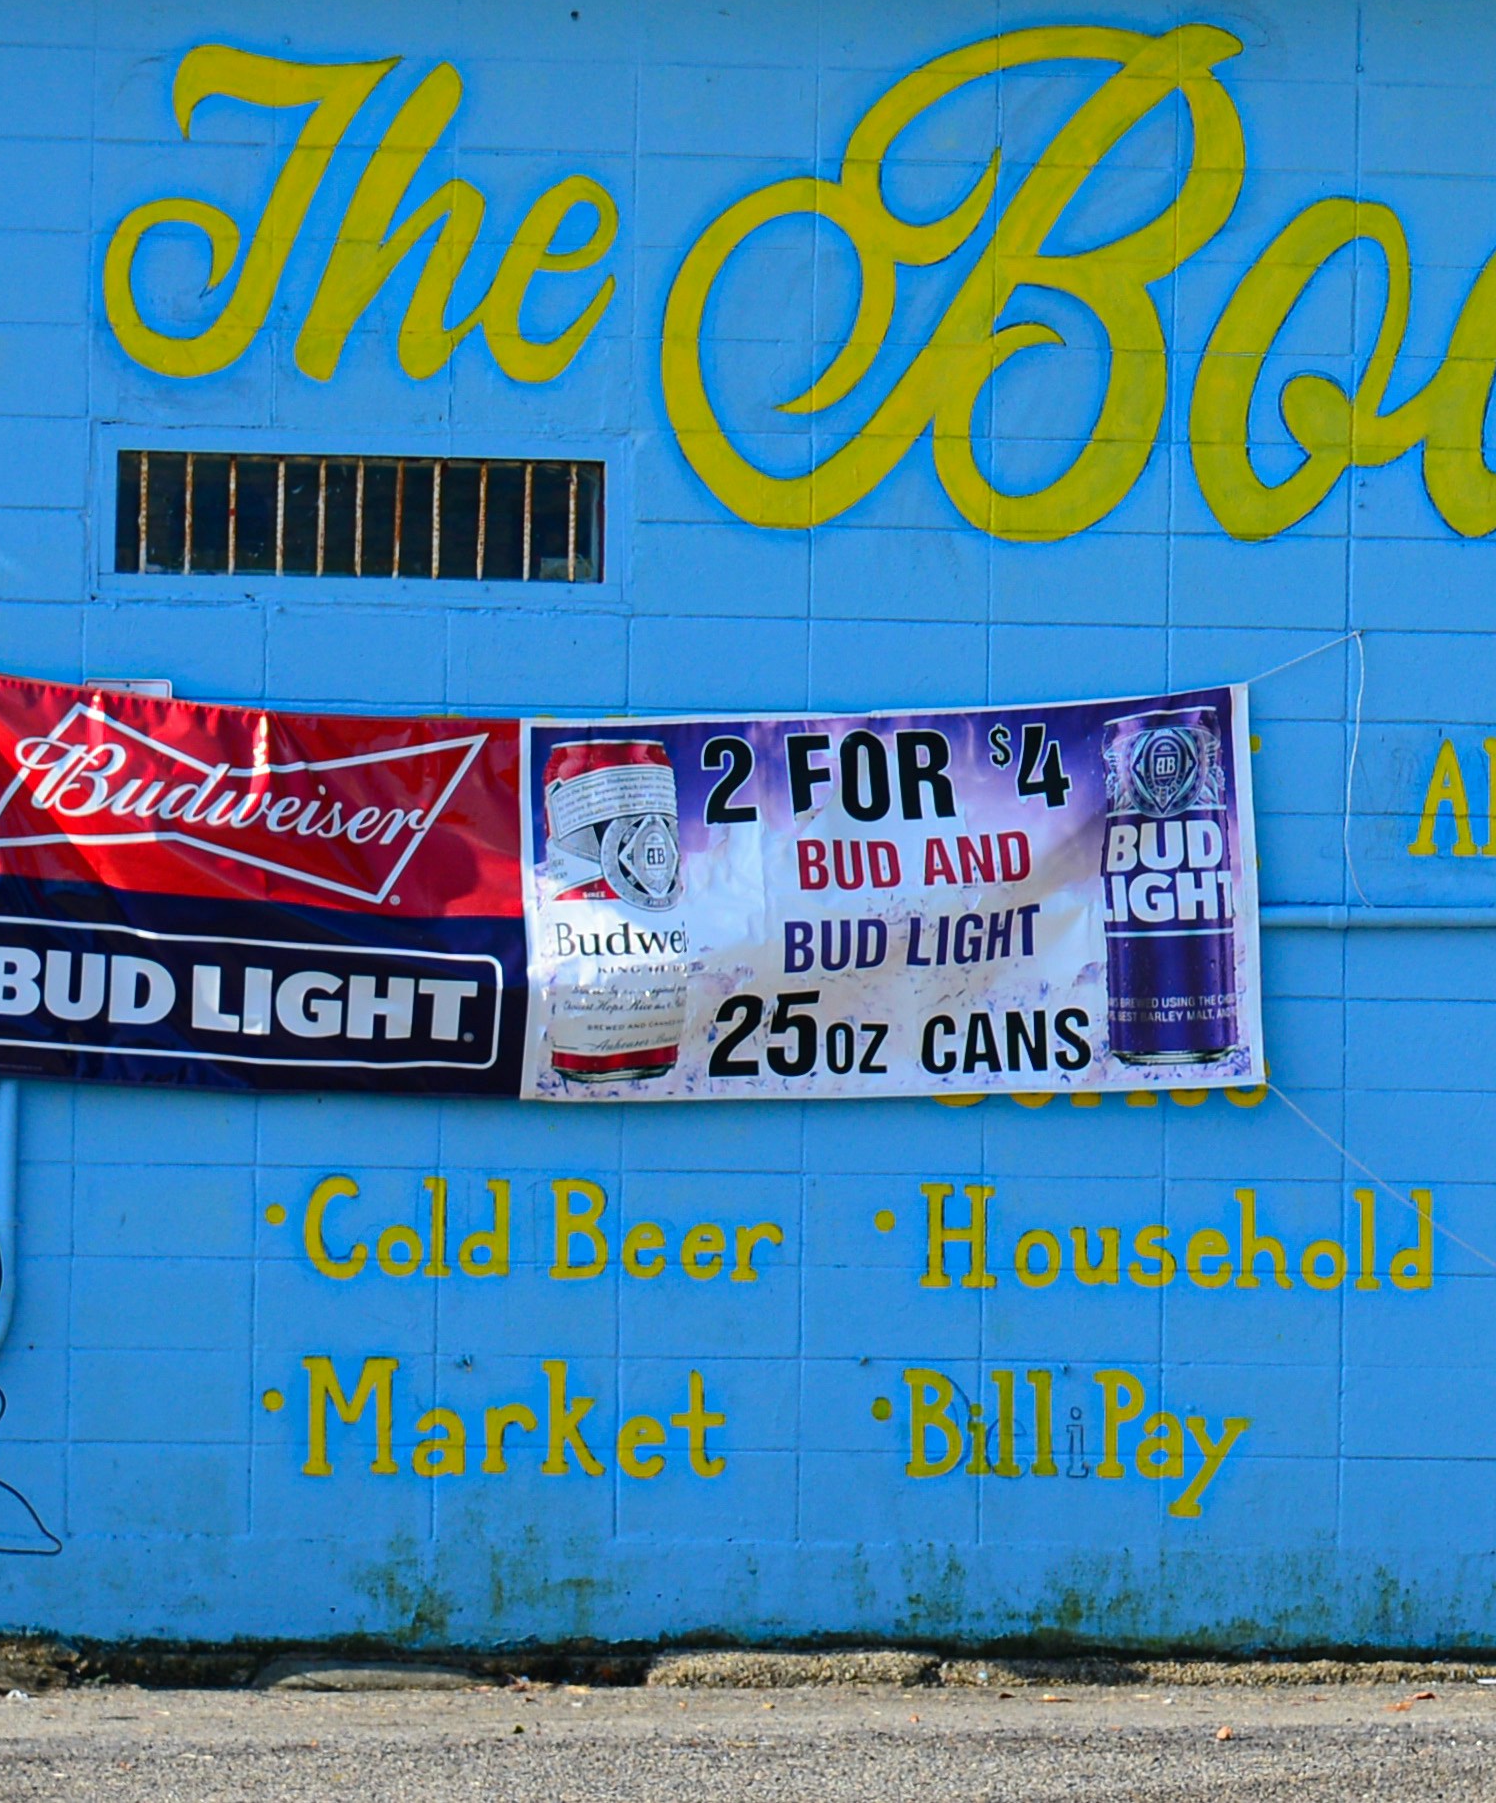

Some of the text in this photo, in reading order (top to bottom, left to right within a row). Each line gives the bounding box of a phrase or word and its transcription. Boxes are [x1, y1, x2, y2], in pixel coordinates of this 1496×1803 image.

[104, 44, 619, 382] The
[15, 736, 426, 846] Budweiser
[702, 736, 758, 825] 2
[786, 729, 957, 823] FOR
[989, 723, 1073, 809] $4
[797, 831, 1031, 891] BUD AND
[1106, 819, 1223, 872] BUD
[784, 903, 1041, 974] BUD LIGHT
[192, 965, 478, 1041] LIGHT
[921, 1008, 1092, 1075] CANS
[1161, 995, 1195, 1009] USING
[305, 1175, 785, 1281] Cold Beer
[920, 1183, 1434, 1290] Household
[302, 1356, 726, 1479] Market
[903, 1368, 1251, 1518] Bill Pay
